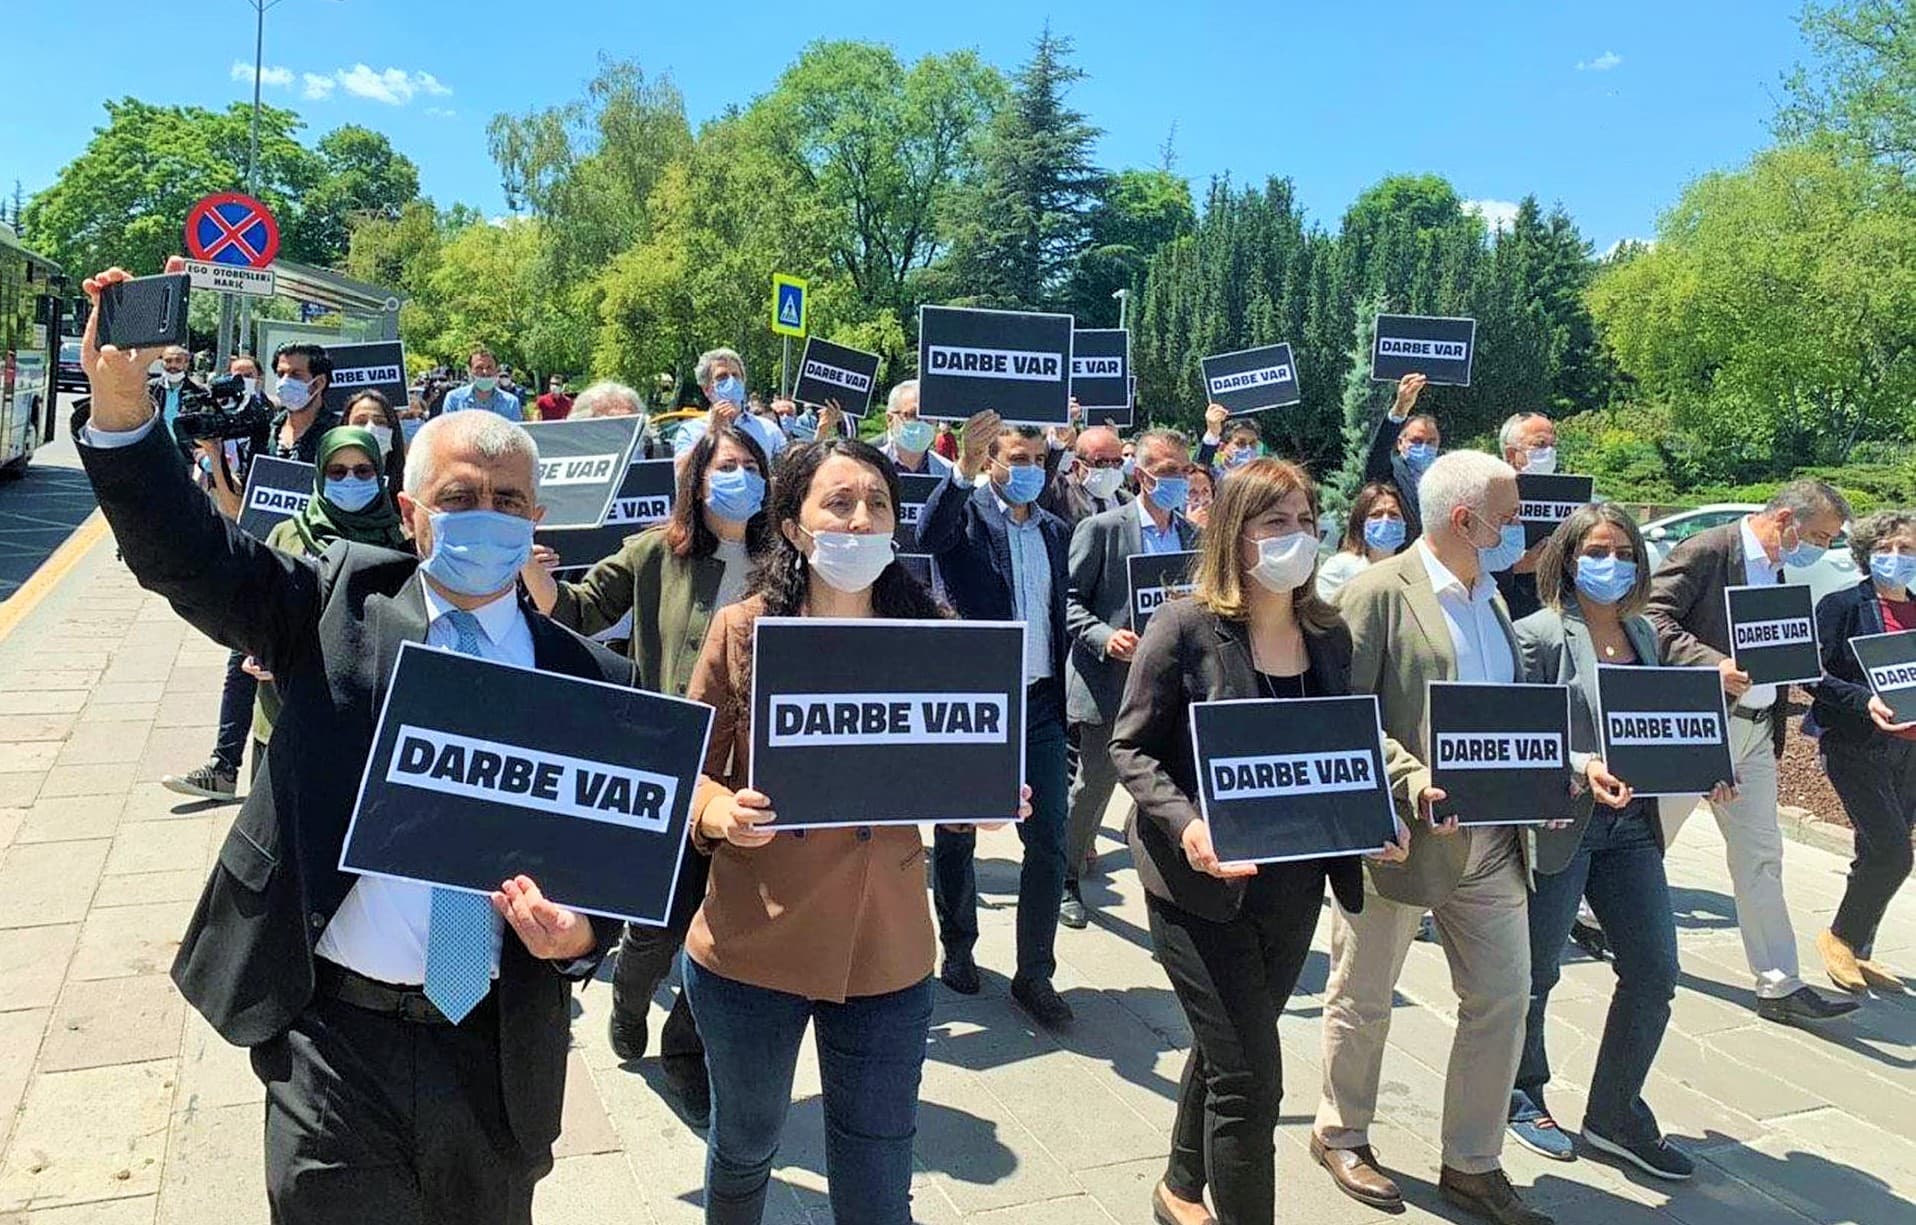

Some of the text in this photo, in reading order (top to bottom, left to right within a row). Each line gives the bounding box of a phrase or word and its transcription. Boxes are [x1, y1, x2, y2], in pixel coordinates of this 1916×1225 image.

[188, 266, 208, 274] EGO
[1381, 341, 1464, 357] DARBE VAR
[931, 351, 1007, 371] DARBE
[1013, 356, 1058, 376] VAR
[1085, 361, 1119, 373] VAR
[330, 368, 397, 384] RBE VAR
[807, 363, 868, 388] DARBE VAR
[1213, 367, 1287, 391] DARBE VAR
[565, 459, 611, 478] VAR
[254, 490, 309, 512] DARB
[622, 500, 666, 518] VAR
[1520, 505, 1551, 516] RBE
[1737, 622, 1809, 643] DARBE VAR
[1874, 667, 1916, 686] DARB
[775, 702, 1000, 736] DARBE VAR
[1611, 717, 1716, 739] DARBE VAR
[1440, 739, 1559, 762] DARBE VAR
[397, 737, 668, 821] DARBE VAR
[1215, 756, 1370, 791] DARBE VAR
